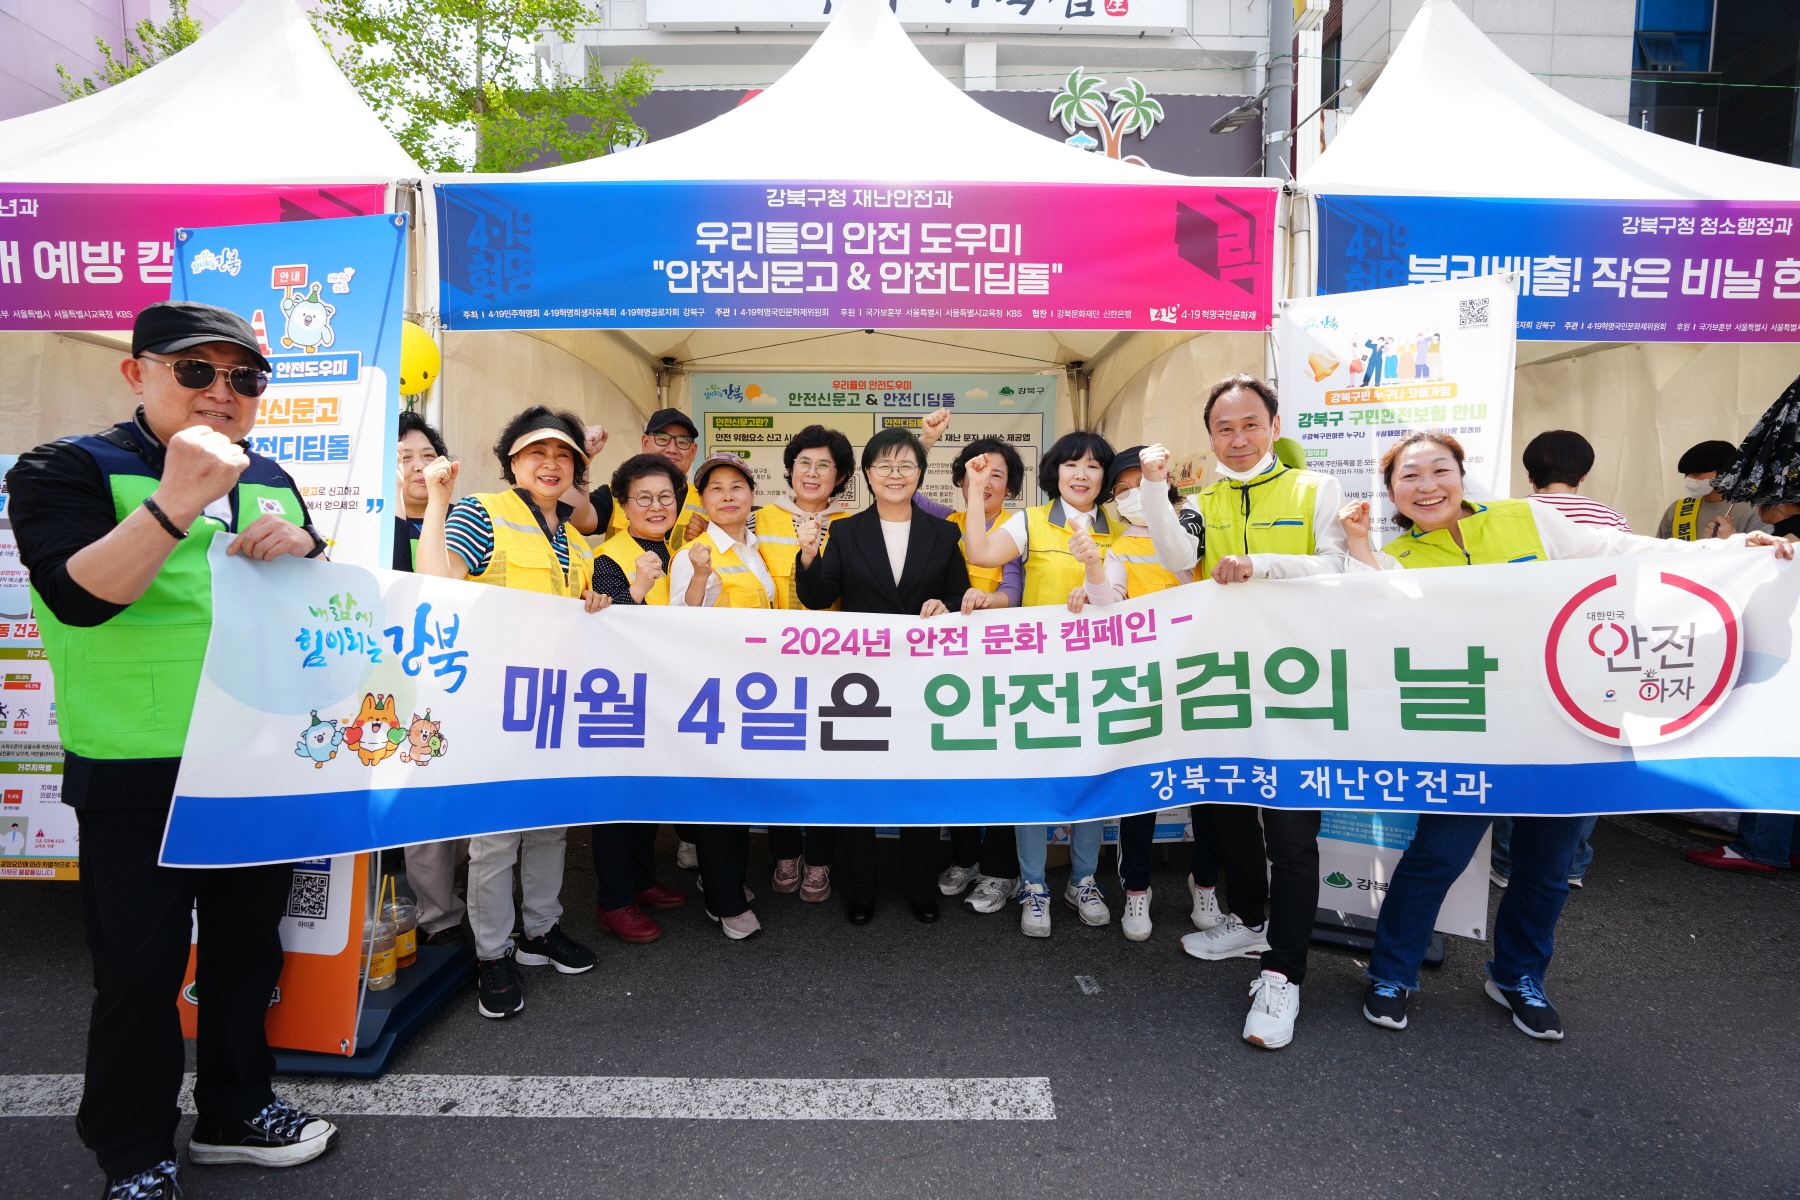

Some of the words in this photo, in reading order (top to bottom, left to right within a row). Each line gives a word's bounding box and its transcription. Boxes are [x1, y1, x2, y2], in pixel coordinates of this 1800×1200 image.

[766, 188, 847, 208] 강북구청
[852, 188, 953, 209] 재난안전과
[1621, 216, 1695, 236] 강북구청
[1699, 217, 1794, 237] 청소행정과
[696, 221, 834, 255] 우리들의
[842, 222, 910, 255] 안전
[920, 223, 1022, 256] 도우미
[33, 240, 126, 284] 예방
[846, 261, 872, 291] &
[1591, 256, 1672, 299] 작은
[1681, 258, 1764, 299] 비닐
[13, 309, 51, 319] 서울특별시
[54, 309, 114, 319] 서울특별시교육청
[116, 310, 134, 319] KBS
[462, 310, 479, 319] 주최
[682, 308, 706, 317] 강북구
[715, 308, 731, 317] 주관
[840, 308, 856, 318] 후원
[905, 308, 942, 318] 서울특별시
[945, 308, 1003, 318] 서울특별시교육청
[1006, 309, 1023, 318] KBS
[1032, 309, 1048, 319] 협찬
[1056, 309, 1101, 319] 강북문화재단
[1103, 309, 1132, 319] 신한은행
[1535, 321, 1556, 330] 강북구
[1564, 321, 1579, 331] 주관
[1676, 322, 1691, 332] 후원
[275, 359, 349, 379] 안전도우미
[832, 380, 867, 391] 우리들의
[868, 379, 913, 391] 안전도우미
[1017, 386, 1045, 395] 강북구
[1330, 391, 1371, 404] 강북구민
[1373, 389, 1406, 401] 누구나
[1407, 385, 1451, 399] 자동가입
[788, 392, 861, 408] 안전신문고
[865, 393, 879, 406] &
[883, 392, 956, 408] 안전디딤돌
[715, 417, 769, 428] 안전신문고란?
[1297, 411, 1344, 429] 강북구
[1348, 405, 1447, 426] 구민안전보험
[1452, 403, 1488, 421] 안내
[715, 433, 732, 442] 안전
[733, 433, 765, 442] 위험요소
[766, 433, 782, 442] 신고
[945, 433, 961, 442] 재난
[963, 433, 980, 442] 문자
[1006, 433, 1031, 442] 제공앱
[328, 486, 360, 497] 신고하고
[1586, 610, 1626, 621] 대한민국
[780, 626, 892, 657] 2024년
[905, 626, 970, 657] 안전
[981, 622, 1048, 655] 문화
[1060, 608, 1158, 653] 캠페인
[383, 602, 469, 694] 강북
[1588, 622, 1696, 673] 안전
[1638, 670, 1696, 704] 하자
[502, 665, 648, 750] 매월
[677, 671, 892, 752] 4일은
[923, 646, 1350, 752] 안전점검의
[1393, 645, 1499, 733] 날
[1150, 763, 1279, 801] 강북구청
[1299, 765, 1493, 805] 재난안전과
[297, 921, 315, 930] 아이폰
